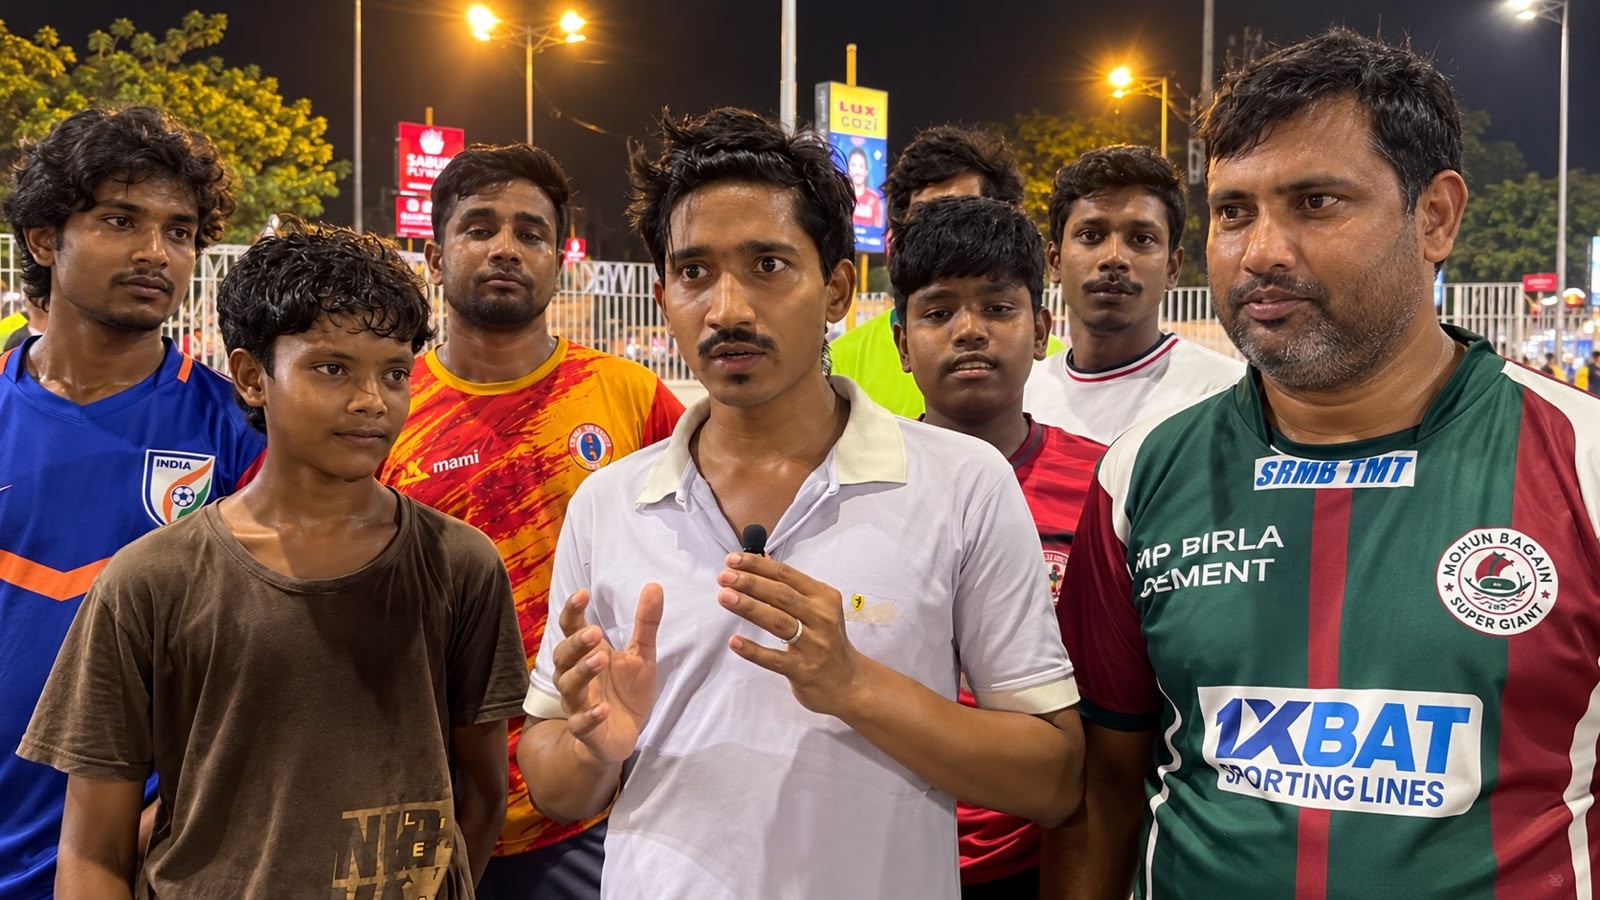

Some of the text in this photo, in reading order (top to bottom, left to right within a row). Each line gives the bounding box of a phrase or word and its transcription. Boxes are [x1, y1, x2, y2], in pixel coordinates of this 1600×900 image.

[839, 101, 875, 116] LUX
[156, 459, 191, 470] INDIA
[433, 450, 479, 473] mami
[1256, 457, 1413, 486] SRMB TMT
[1182, 525, 1285, 558] BIRLA
[1443, 533, 1552, 582] MOHUN BAGAIN
[1450, 597, 1543, 630] SUPER GIANT
[1215, 698, 1471, 774] 1XBAT
[1219, 763, 1444, 808] SPORTING LINES
